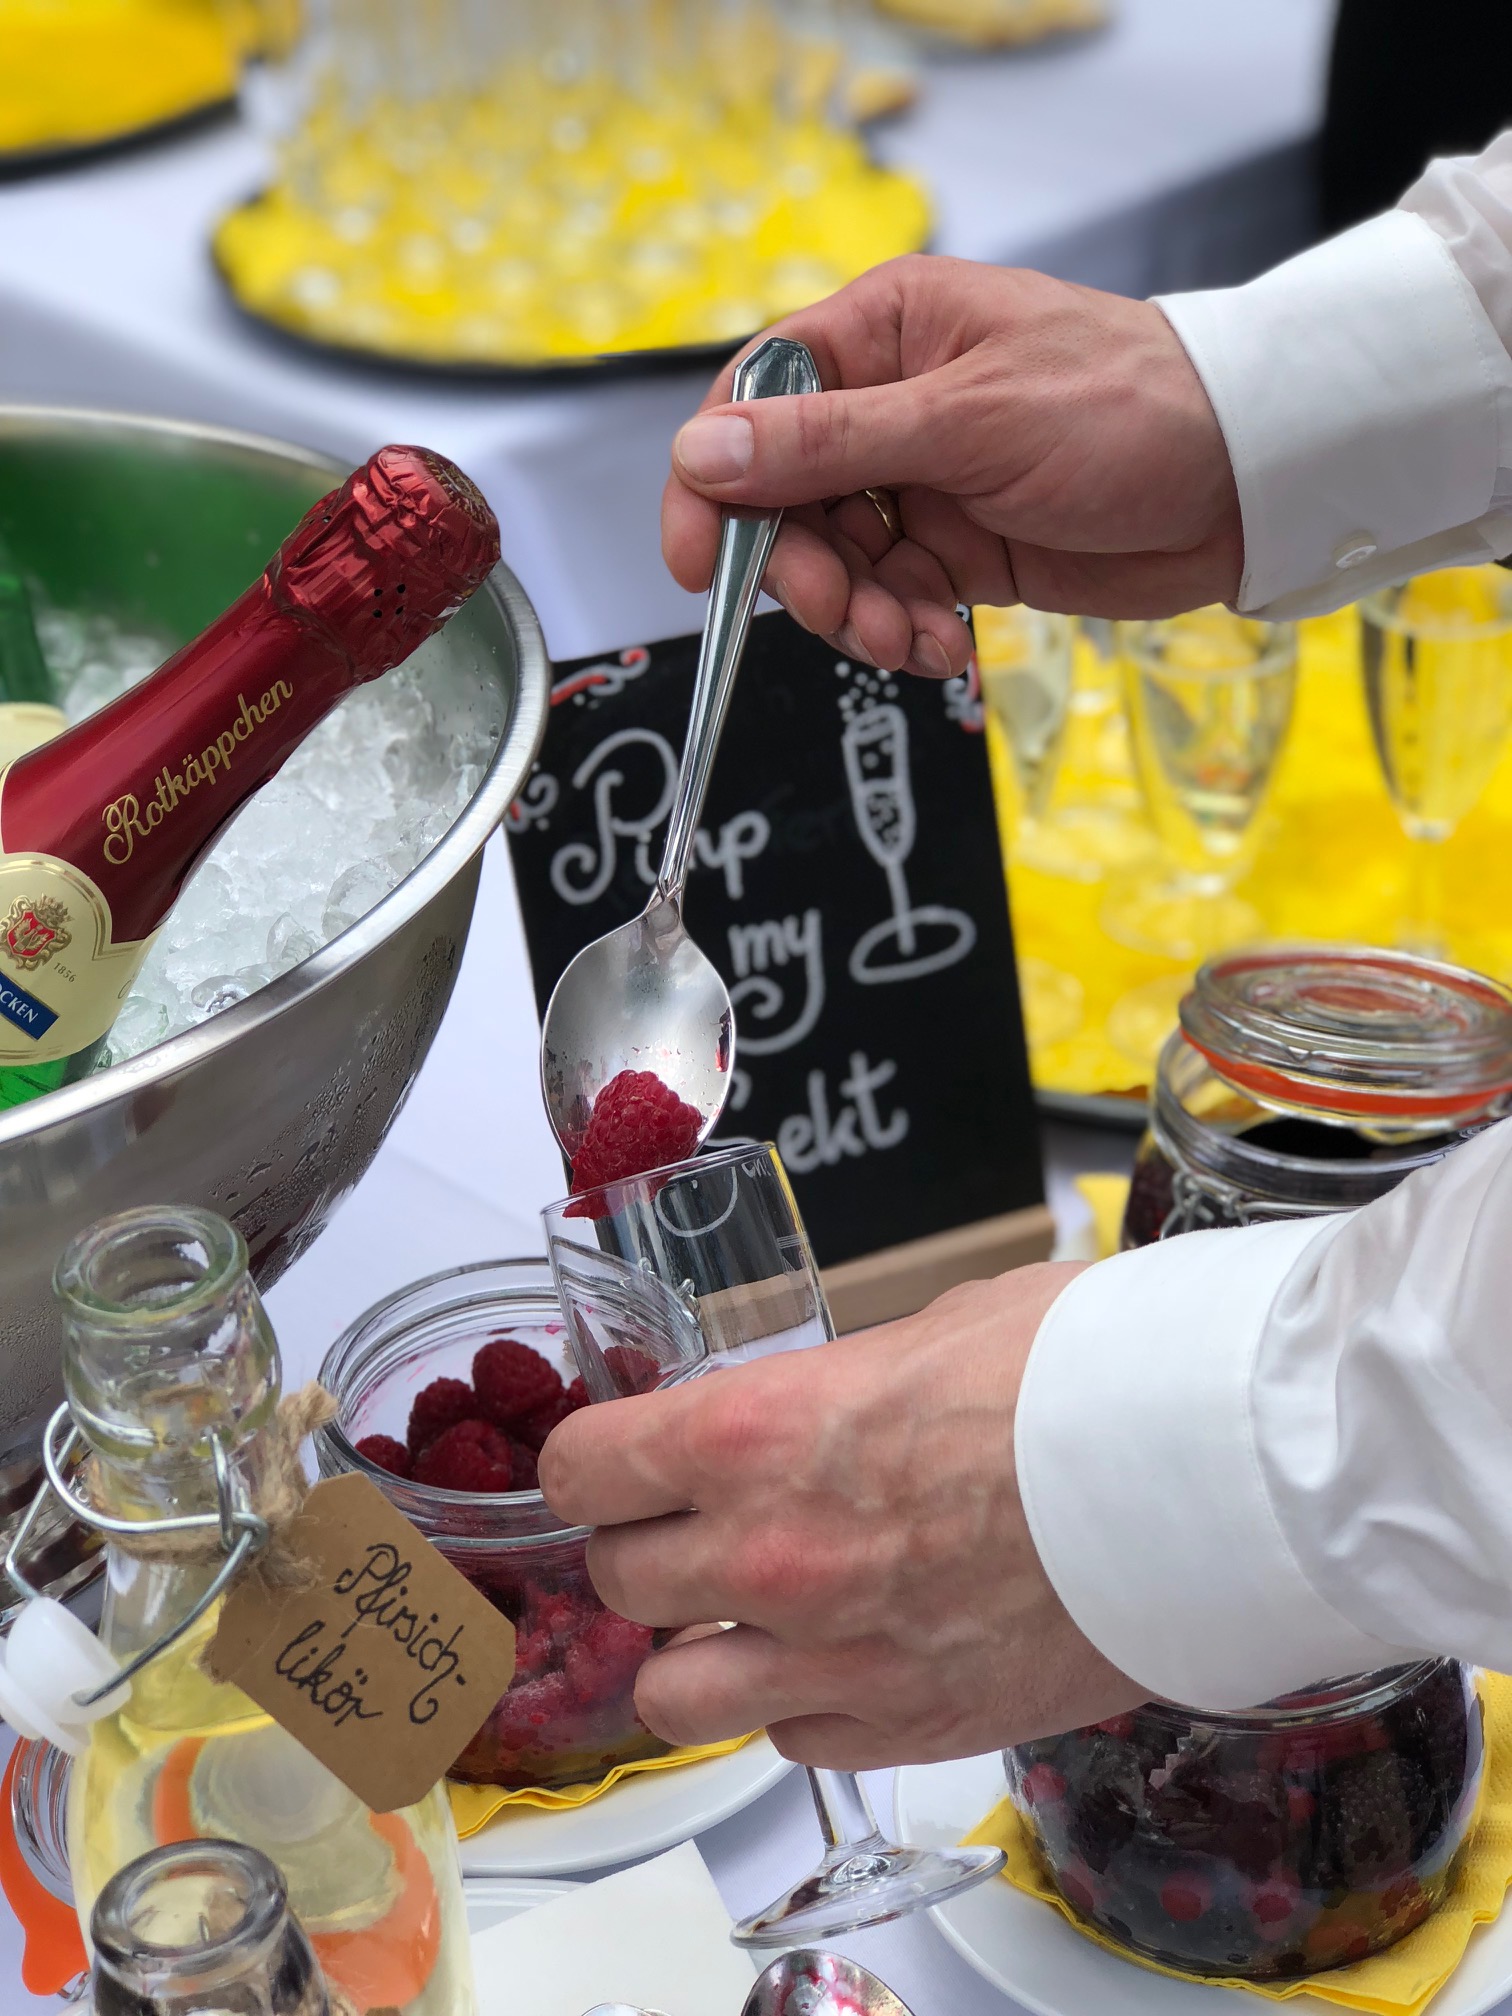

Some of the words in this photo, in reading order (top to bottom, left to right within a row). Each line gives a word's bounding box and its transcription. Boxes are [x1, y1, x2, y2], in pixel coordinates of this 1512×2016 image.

[101, 678, 294, 866] Rotkäppchen
[0, 982, 39, 1024] CKEN
[53, 962, 77, 984] 1856
[727, 908, 825, 1055] my
[705, 1050, 910, 1175] ekt
